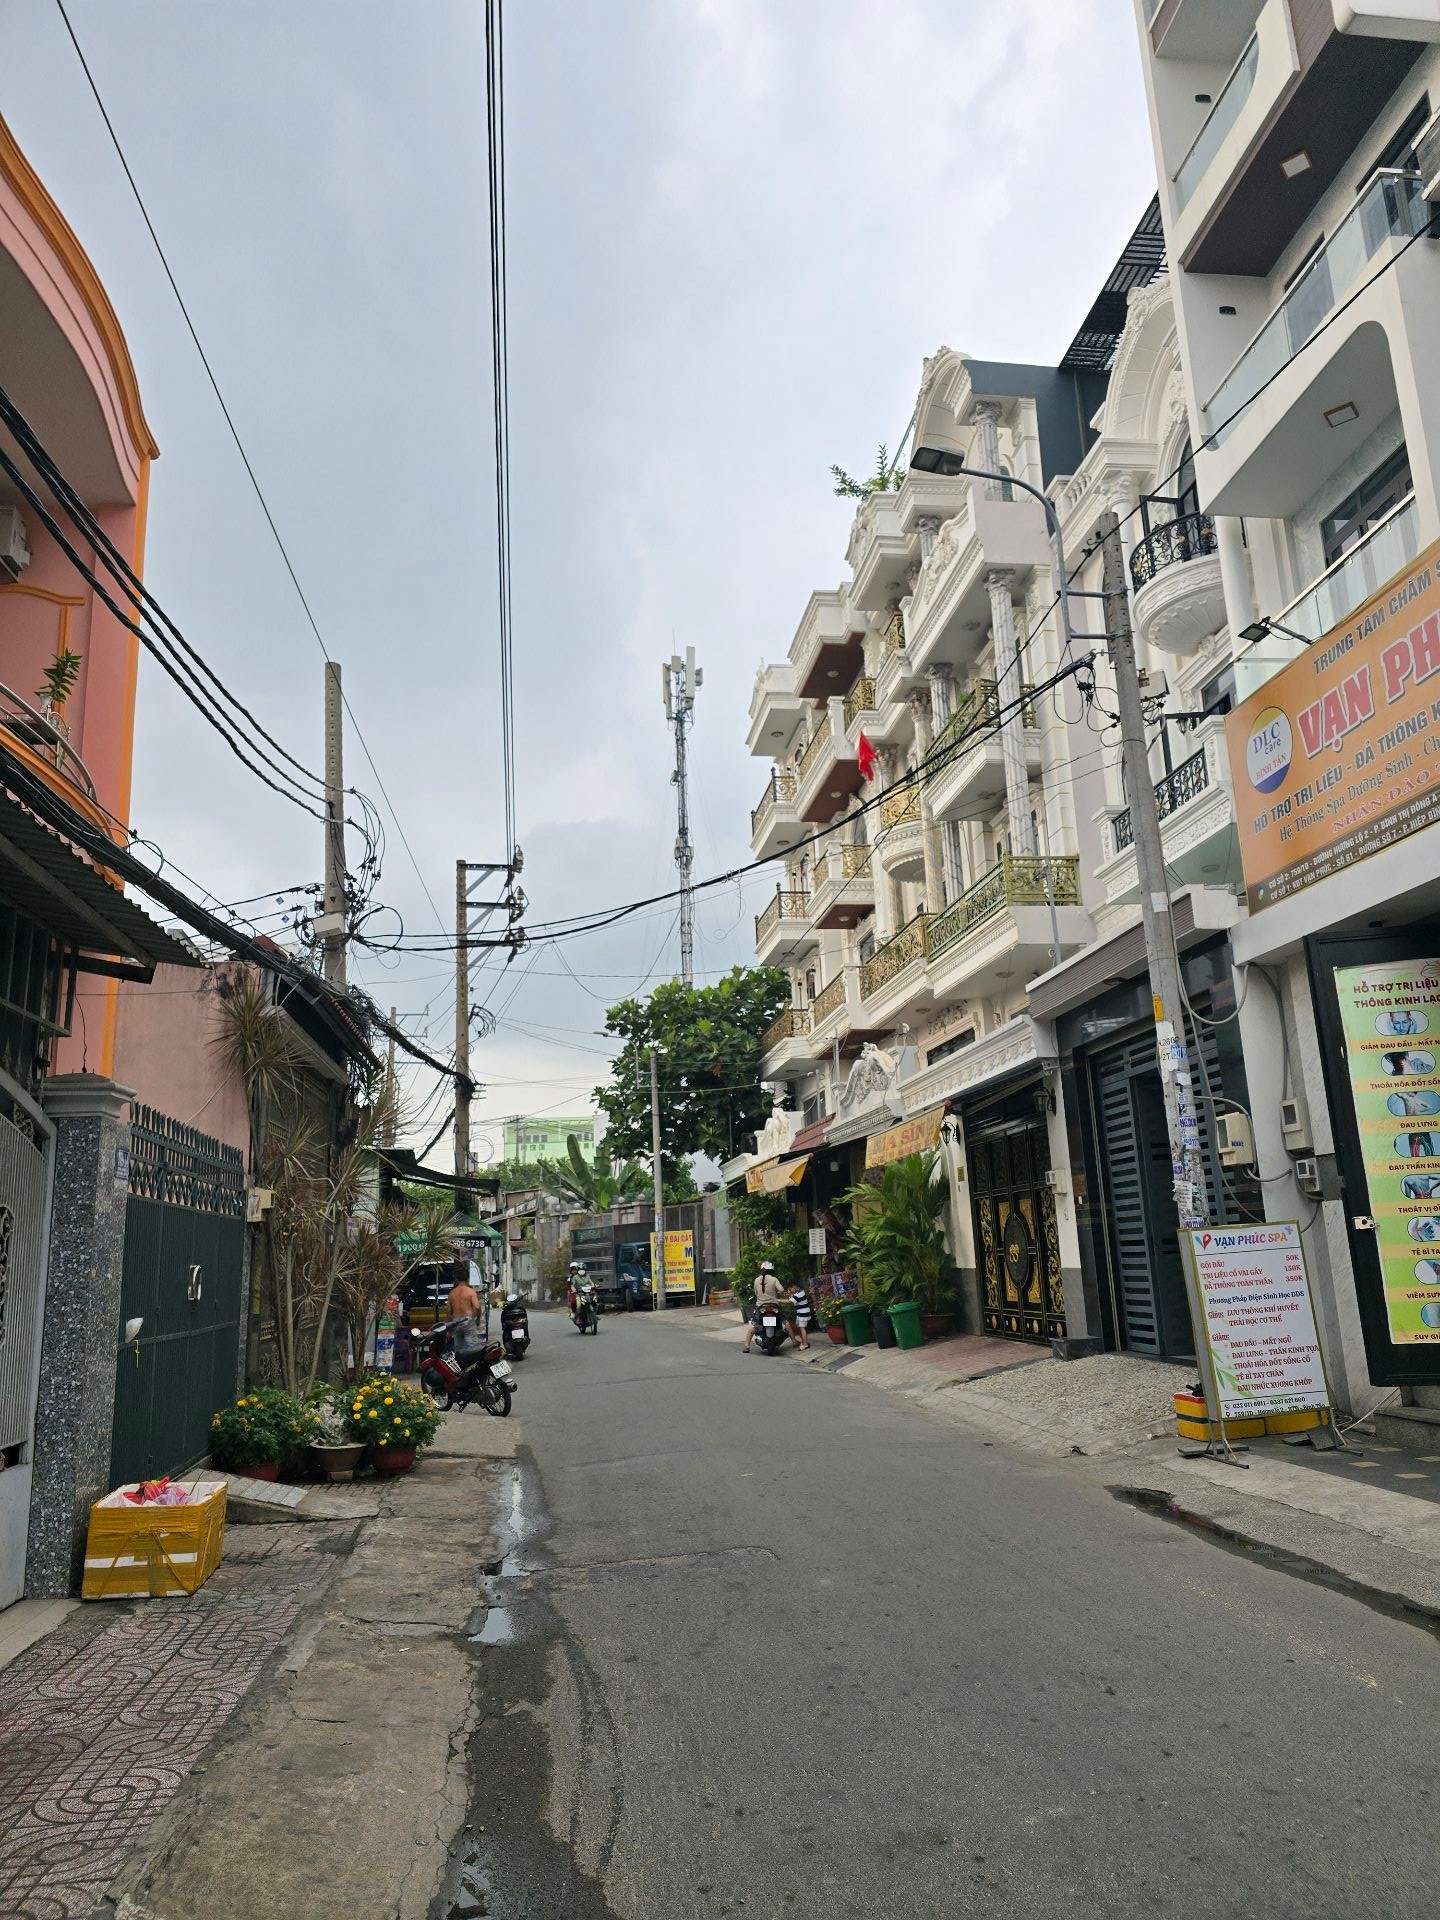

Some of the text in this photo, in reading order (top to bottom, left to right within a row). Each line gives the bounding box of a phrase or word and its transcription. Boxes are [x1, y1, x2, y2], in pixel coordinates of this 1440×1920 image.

[1313, 633, 1354, 674] TRUNG
[1356, 606, 1387, 641] TÂM
[1388, 568, 1432, 616] CHĂM
[1296, 664, 1376, 759] VẠN
[1253, 722, 1280, 753] DLC
[1264, 738, 1282, 755] care
[1270, 796, 1292, 823] TRỢ
[1294, 784, 1313, 807] TRỊ
[1315, 765, 1343, 794] LIỆU
[1377, 710, 1428, 754] THÔNG
[1280, 824, 1292, 841] Hệ
[1294, 807, 1324, 832] Thống
[1326, 796, 1345, 814] Spa
[1385, 752, 1413, 778] Sinh
[1380, 814, 1398, 830] BÌNH
[1397, 808, 1410, 820] TRỊ
[1410, 797, 1431, 814] ĐÔNG
[1345, 852, 1354, 862] 81
[1371, 982, 1394, 993] TRỢ
[1395, 981, 1414, 992] TRỊ
[1415, 977, 1439, 991] LIỆU
[1354, 997, 1393, 1008] THÔNG
[1394, 996, 1421, 1006] KINH
[1418, 1037, 1434, 1046] MẤT
[1417, 1120, 1439, 1128] LƯNG
[466, 1240, 485, 1248] 6738
[1214, 1231, 1288, 1249] VẠN PHÚC SPA
[1232, 1295, 1248, 1303] Pháp
[1278, 1292, 1291, 1300] Học
[1406, 1291, 1426, 1299] VIÊM
[1264, 1304, 1277, 1313] KHÍ
[1288, 1346, 1305, 1354] KINH
